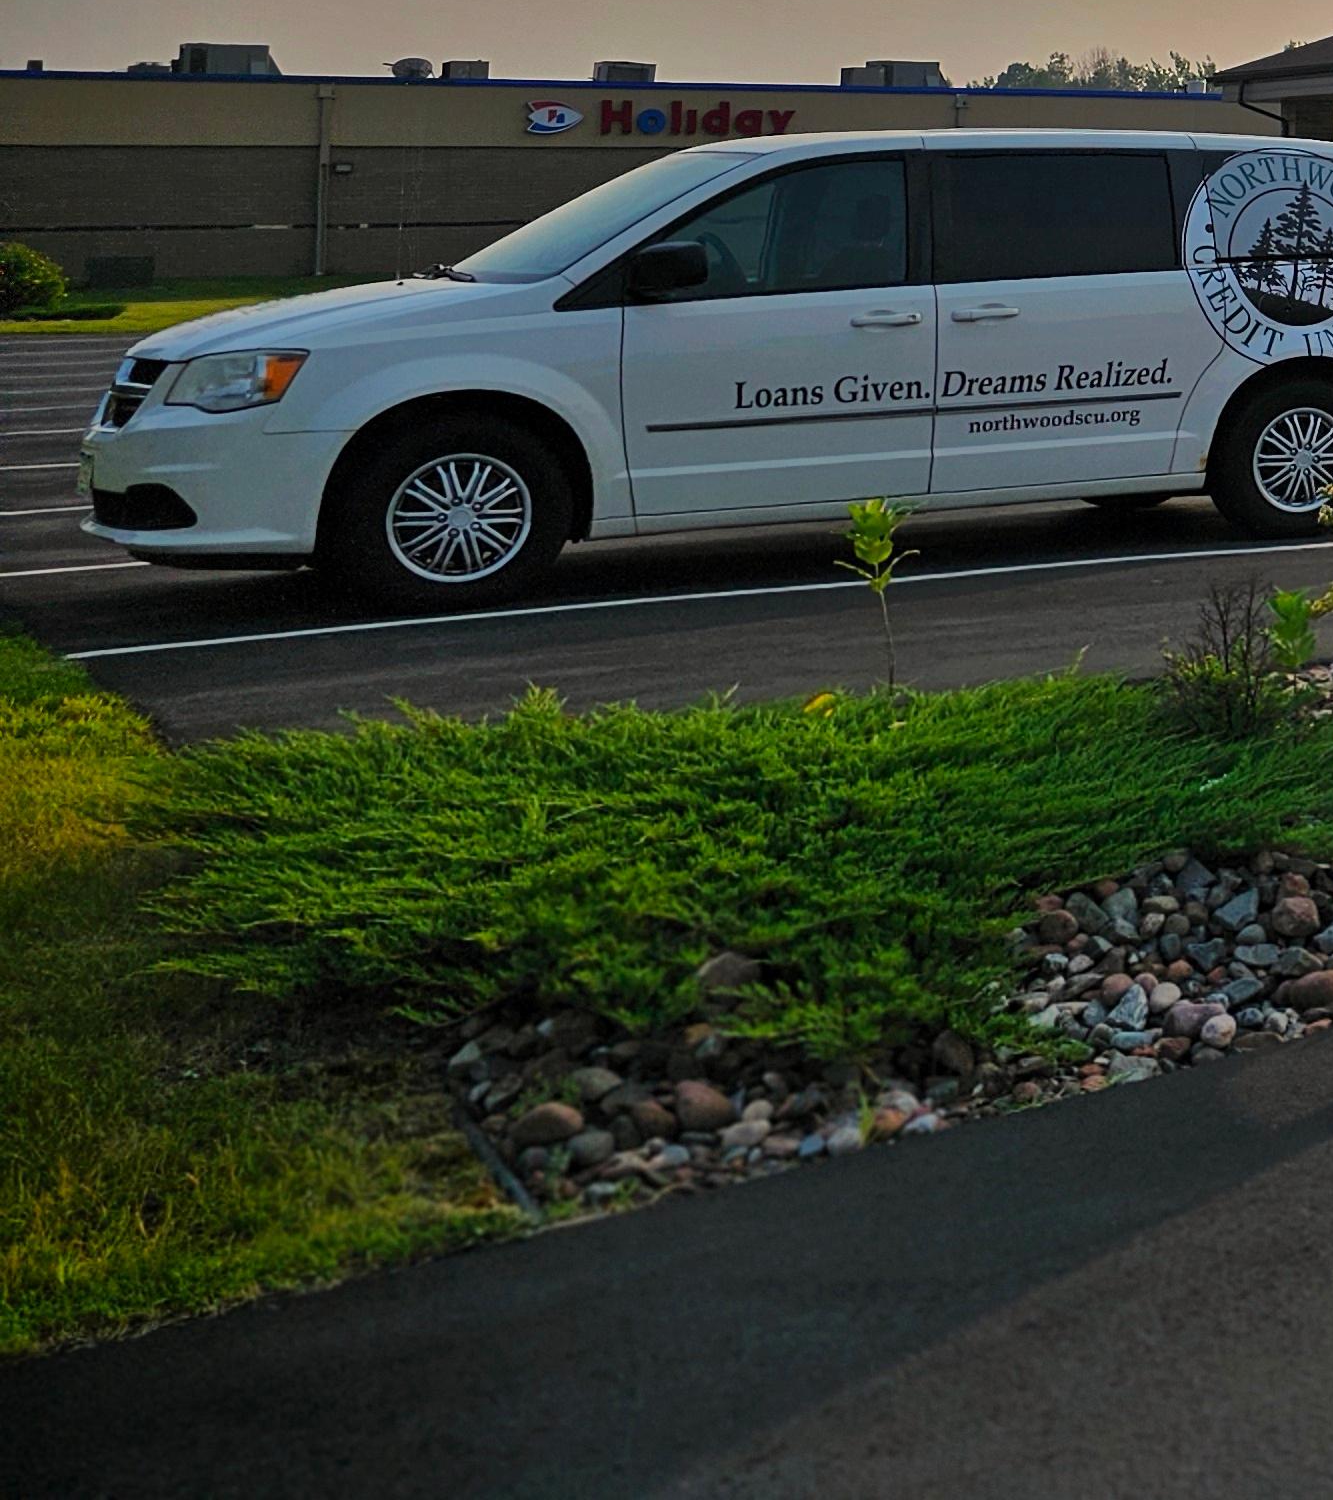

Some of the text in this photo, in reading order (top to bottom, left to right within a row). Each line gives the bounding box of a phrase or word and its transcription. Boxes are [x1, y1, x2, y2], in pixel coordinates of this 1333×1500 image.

[601, 99, 797, 136] Holiday
[1192, 245, 1284, 357] CREDIT
[734, 357, 1174, 410] Loans Given. Dreams Realized.
[969, 407, 1141, 435] northwoodscu.org
